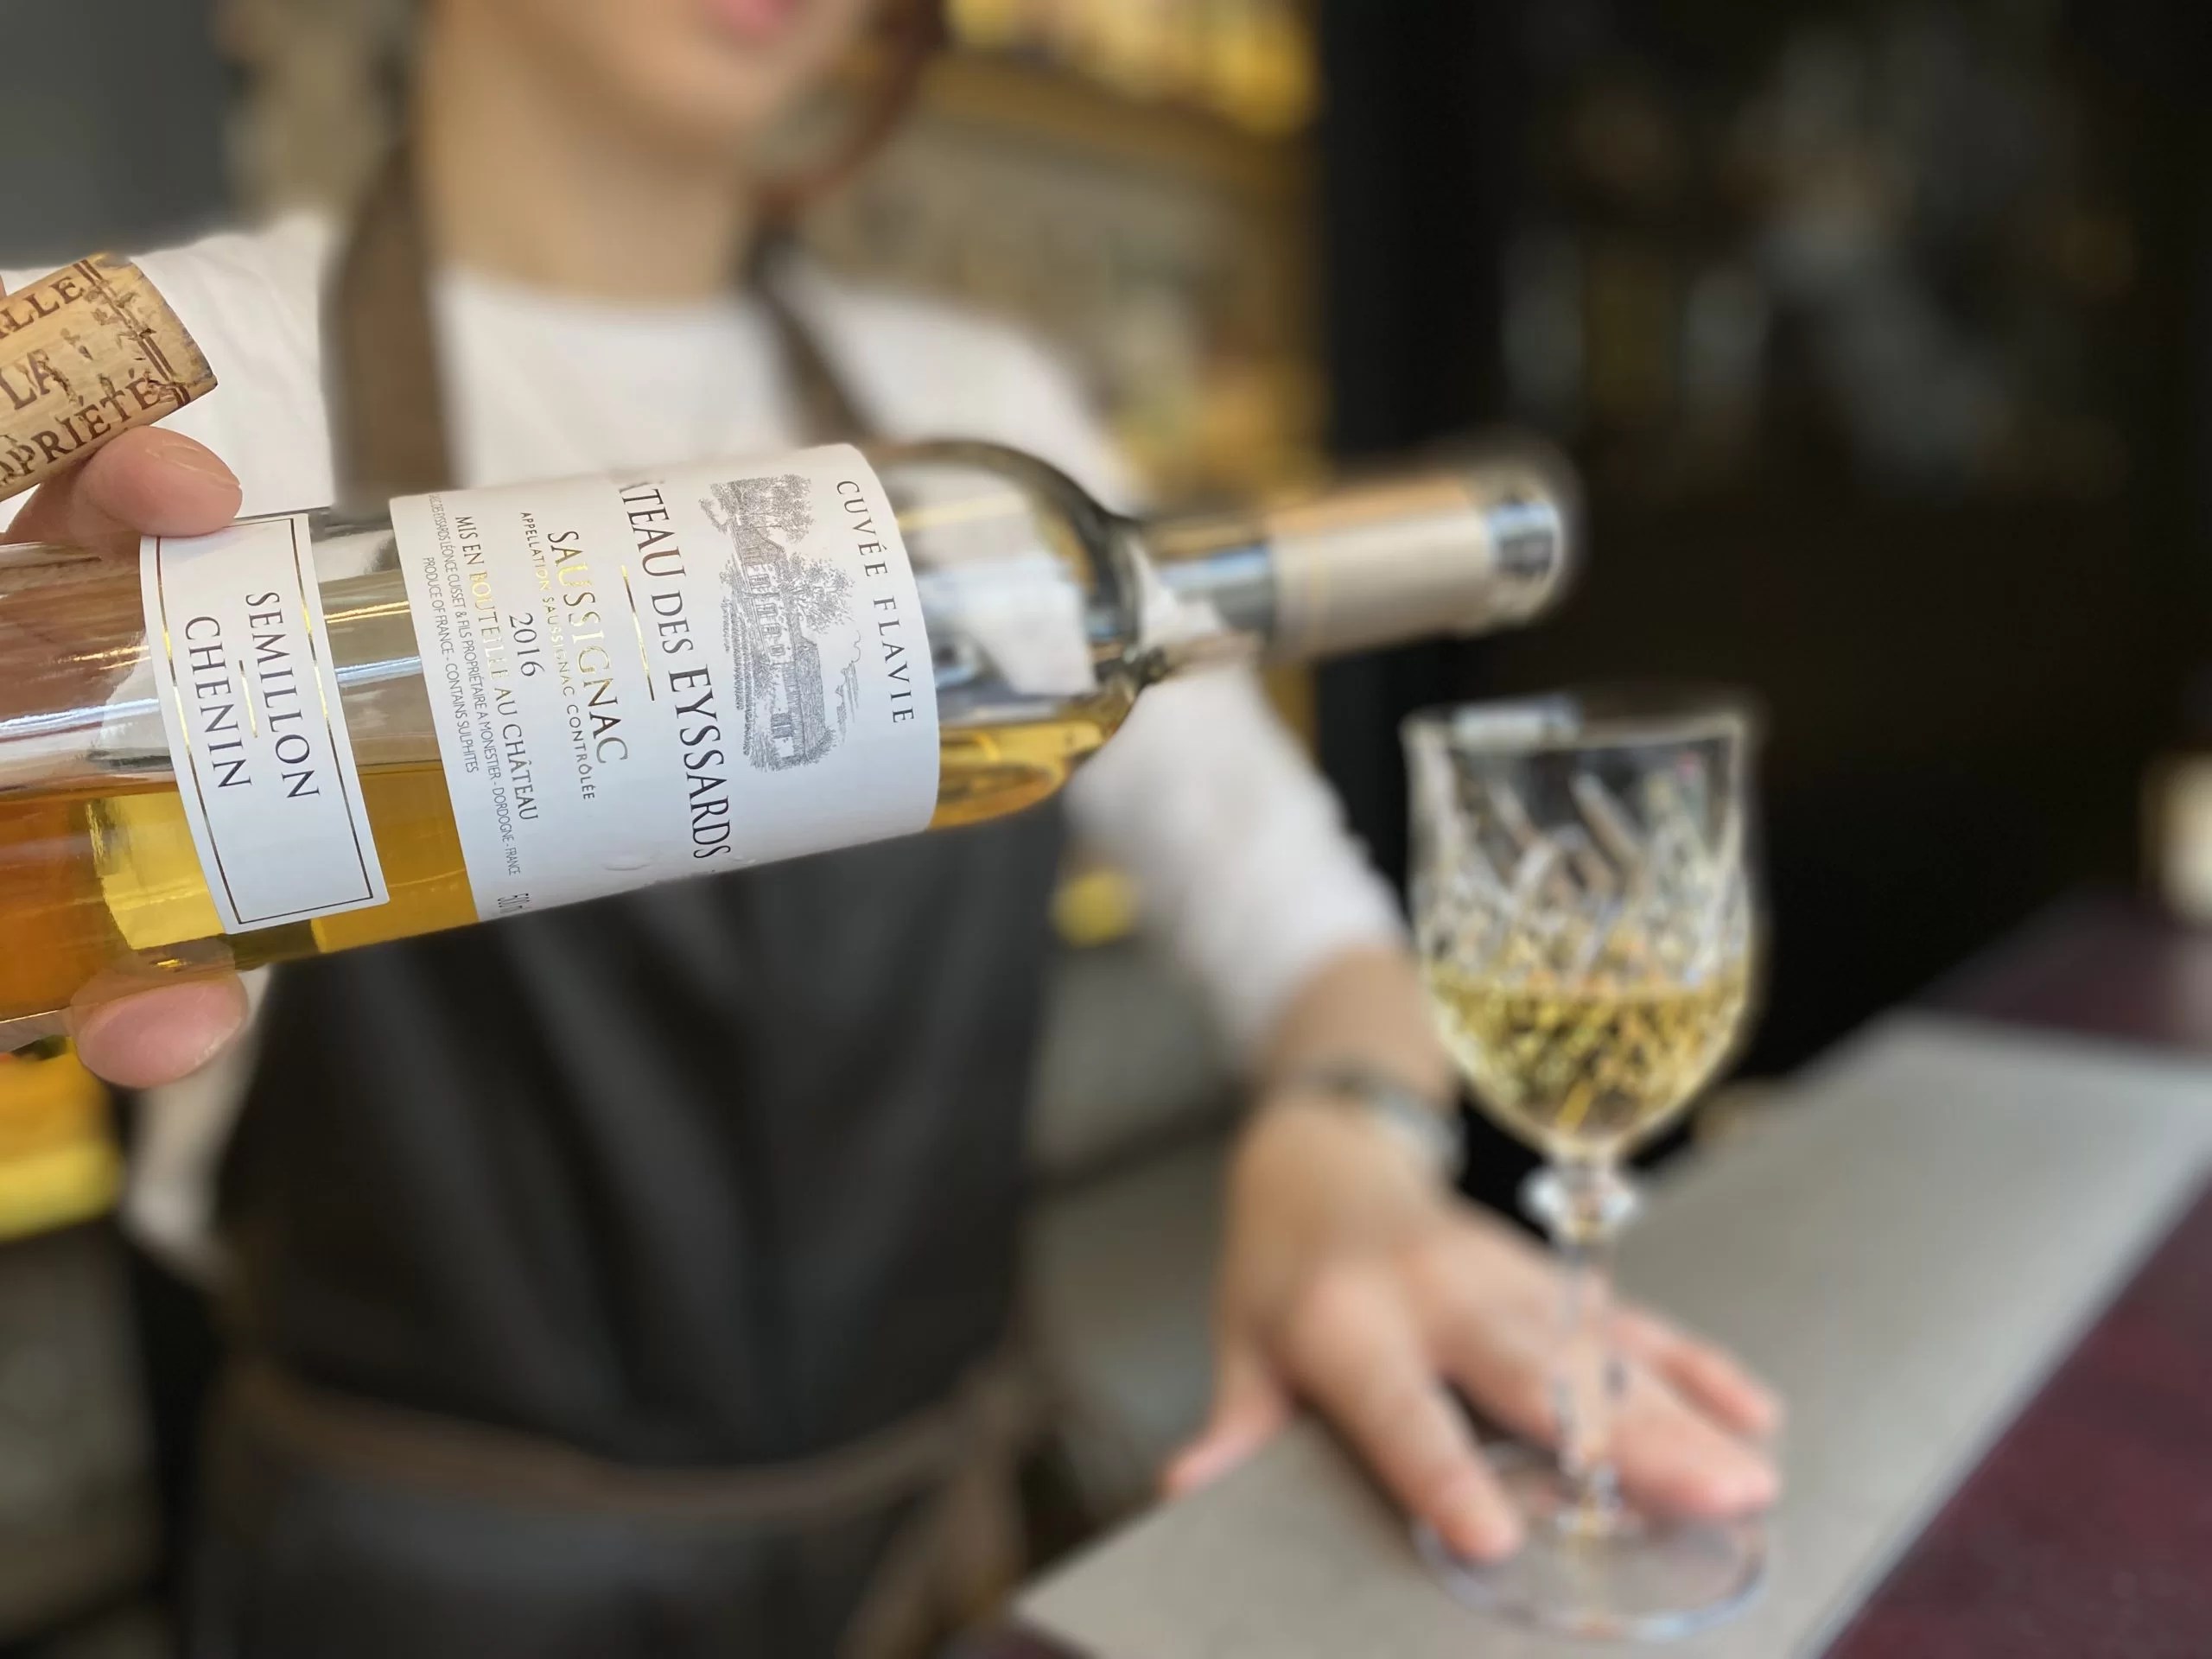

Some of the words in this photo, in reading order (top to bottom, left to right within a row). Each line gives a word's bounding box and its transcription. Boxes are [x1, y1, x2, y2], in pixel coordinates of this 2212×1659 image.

[0, 349, 70, 410] LA
[439, 541, 458, 573] LÉONCE
[454, 517, 479, 539] MIS
[462, 543, 484, 565] EN
[619, 483, 686, 577] TEAU
[423, 557, 442, 601] PRODUCE
[431, 600, 446, 613] OF
[448, 574, 467, 608] CUISSET
[836, 480, 889, 577] CUVÉE
[873, 595, 915, 723] FLAVIE
[435, 614, 455, 655] FRANCE
[457, 620, 472, 638] FILS
[468, 571, 509, 680] BOUTEILLE
[509, 613, 545, 677] 2016
[546, 531, 629, 764] SAUSSIGNAC
[650, 589, 694, 654] DES
[461, 639, 487, 709] PROPRIÉTAIRE
[520, 512, 551, 590] APPELLATION
[543, 595, 575, 698] SAUSSIGNAC
[567, 704, 596, 800] CONTRÔLÉE
[184, 615, 253, 788] CHENIN
[245, 591, 321, 798] SEMILLON
[445, 664, 467, 719] CONTAINS
[493, 688, 518, 715] AU
[457, 721, 479, 772] SULPHITES
[479, 721, 501, 781] MONESTIER
[503, 723, 538, 821] CHÂTEAU
[668, 664, 733, 861] EYSSARDS
[493, 787, 514, 842] DORDOGNE
[505, 847, 521, 876] FRANCE
